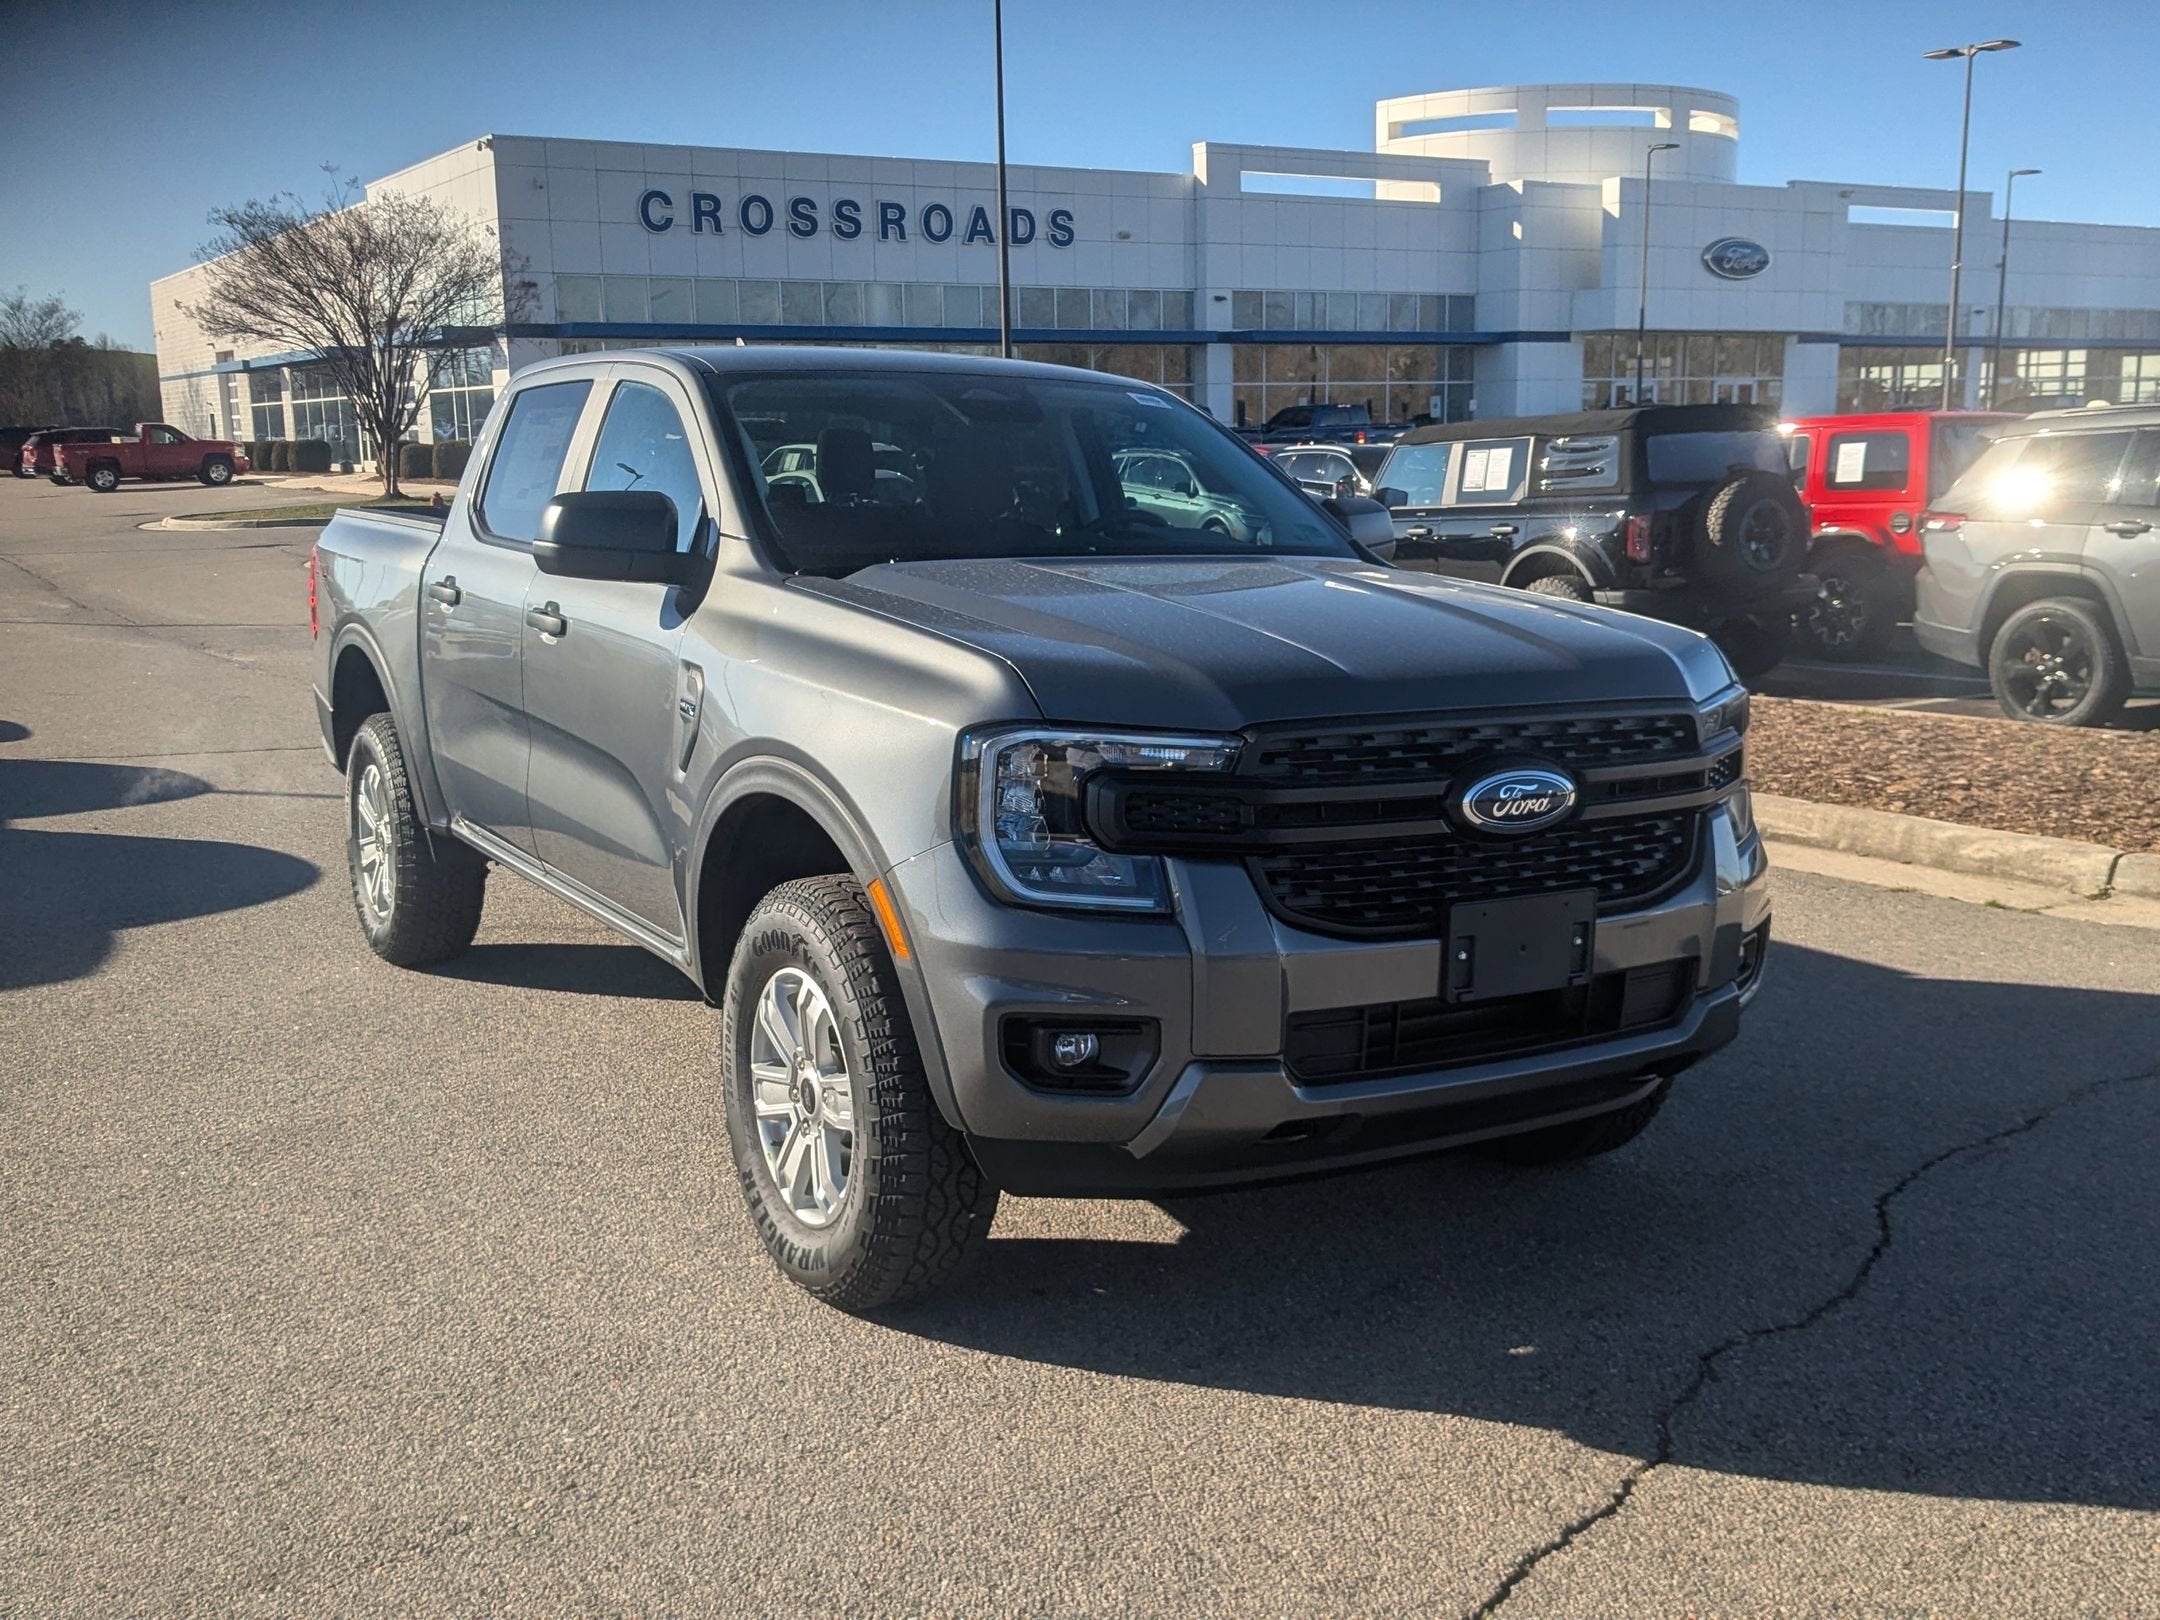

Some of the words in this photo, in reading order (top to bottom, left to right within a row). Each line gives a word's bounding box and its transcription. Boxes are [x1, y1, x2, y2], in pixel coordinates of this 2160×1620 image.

[639, 190, 1076, 249] CROSSROADS
[1723, 247, 1763, 268] Ford
[1493, 784, 1552, 817] Ford
[742, 1167, 826, 1271] WRANGLER
